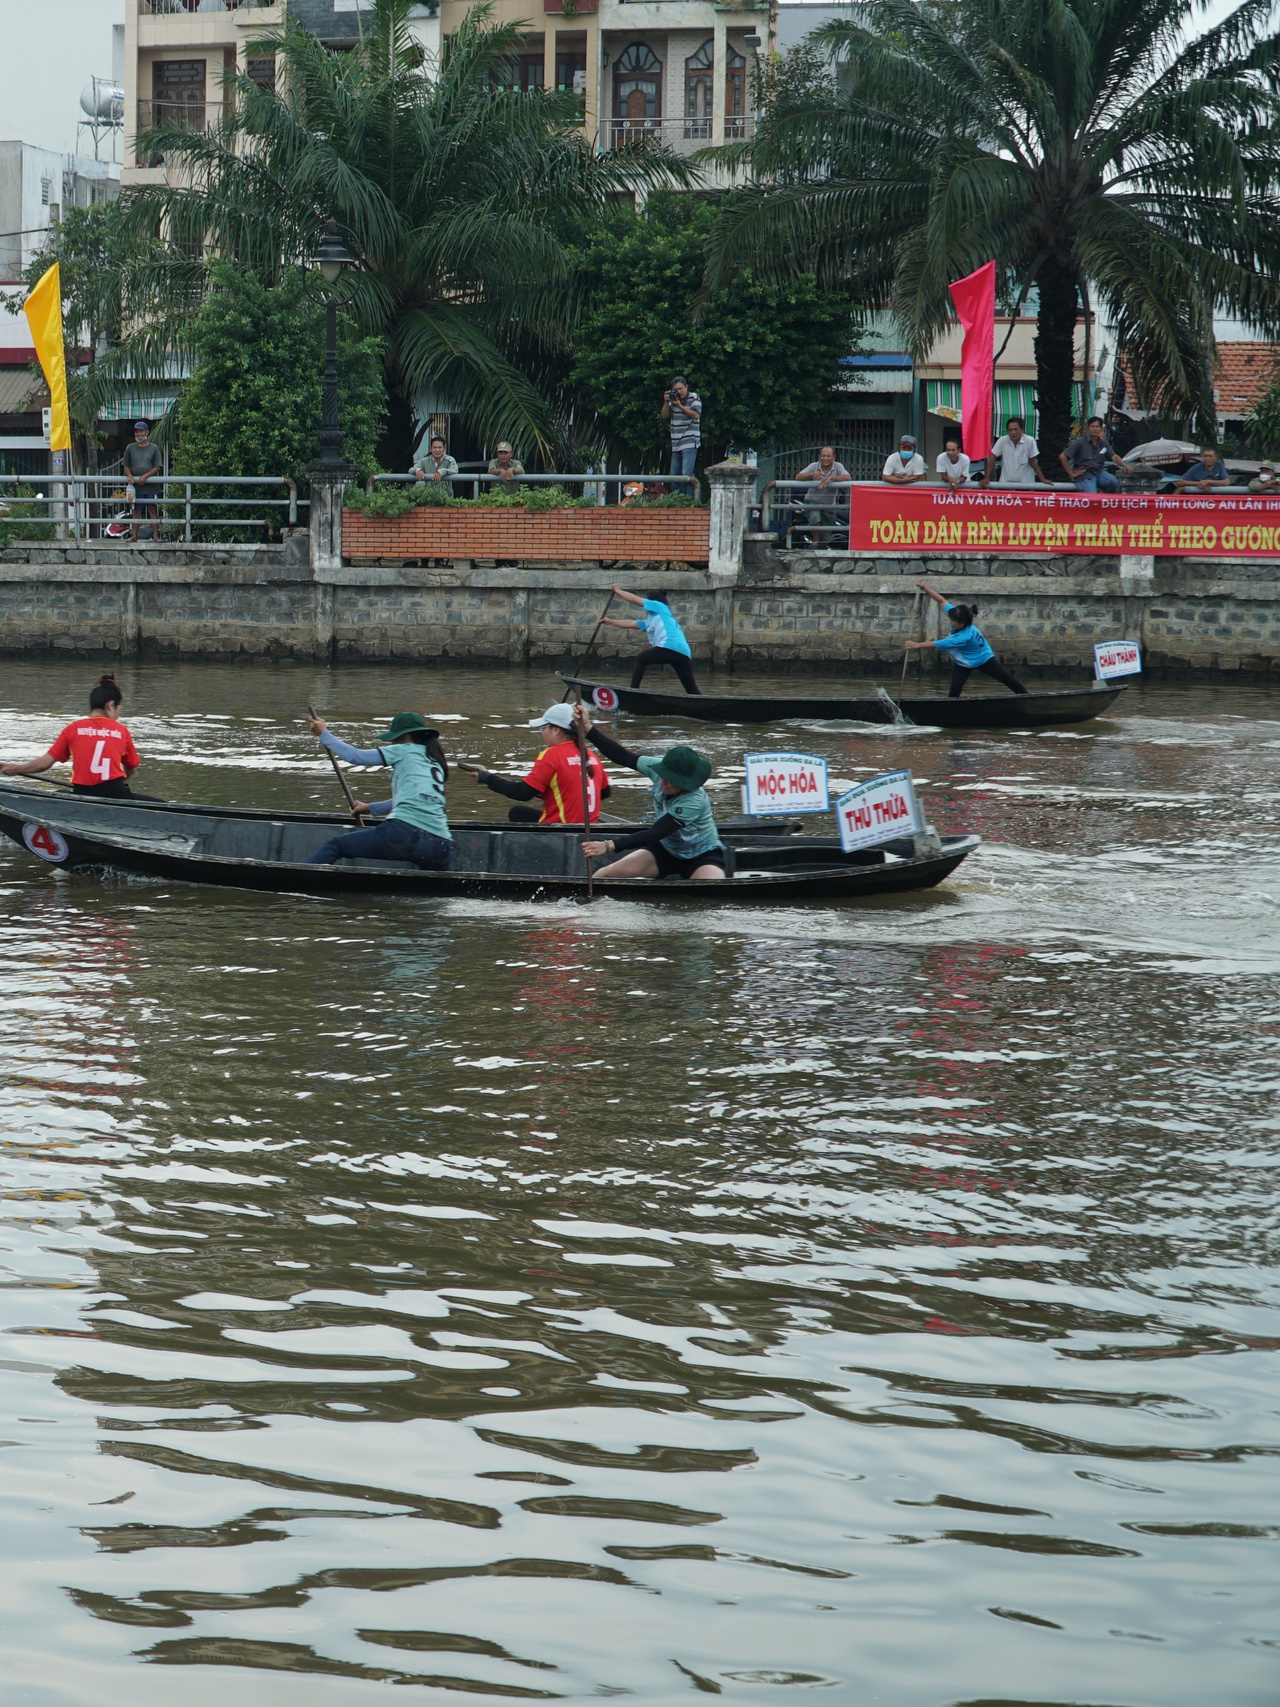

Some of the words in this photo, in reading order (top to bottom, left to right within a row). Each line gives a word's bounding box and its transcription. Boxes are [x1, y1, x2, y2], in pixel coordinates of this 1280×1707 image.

[967, 493, 994, 506] VĂN
[997, 494, 1023, 507] HÓA
[1034, 492, 1056, 508] THỂ
[1059, 497, 1090, 509] THAO
[1101, 498, 1119, 509] DU
[1122, 498, 1148, 511] LỊCH
[1183, 498, 1216, 510] LONG
[1218, 499, 1237, 510] AN
[1265, 498, 1280, 511] TH
[870, 513, 920, 544] TOÀN
[923, 515, 963, 545] DÂN
[966, 515, 1004, 545] RÈN
[1008, 517, 1070, 551] LUYỆN
[1074, 518, 1124, 547] THÂN
[1127, 513, 1164, 548] THỂ
[1168, 525, 1217, 549] THEO
[1100, 651, 1116, 667] CHÂU
[1116, 648, 1138, 664] THÀNH
[597, 688, 614, 708] 9
[90, 740, 111, 780] 4
[757, 768, 786, 800] MỘC
[789, 766, 818, 794] HÓA
[845, 797, 873, 833] THỦ
[872, 793, 909, 825] THỪA
[30, 826, 60, 856] 4
